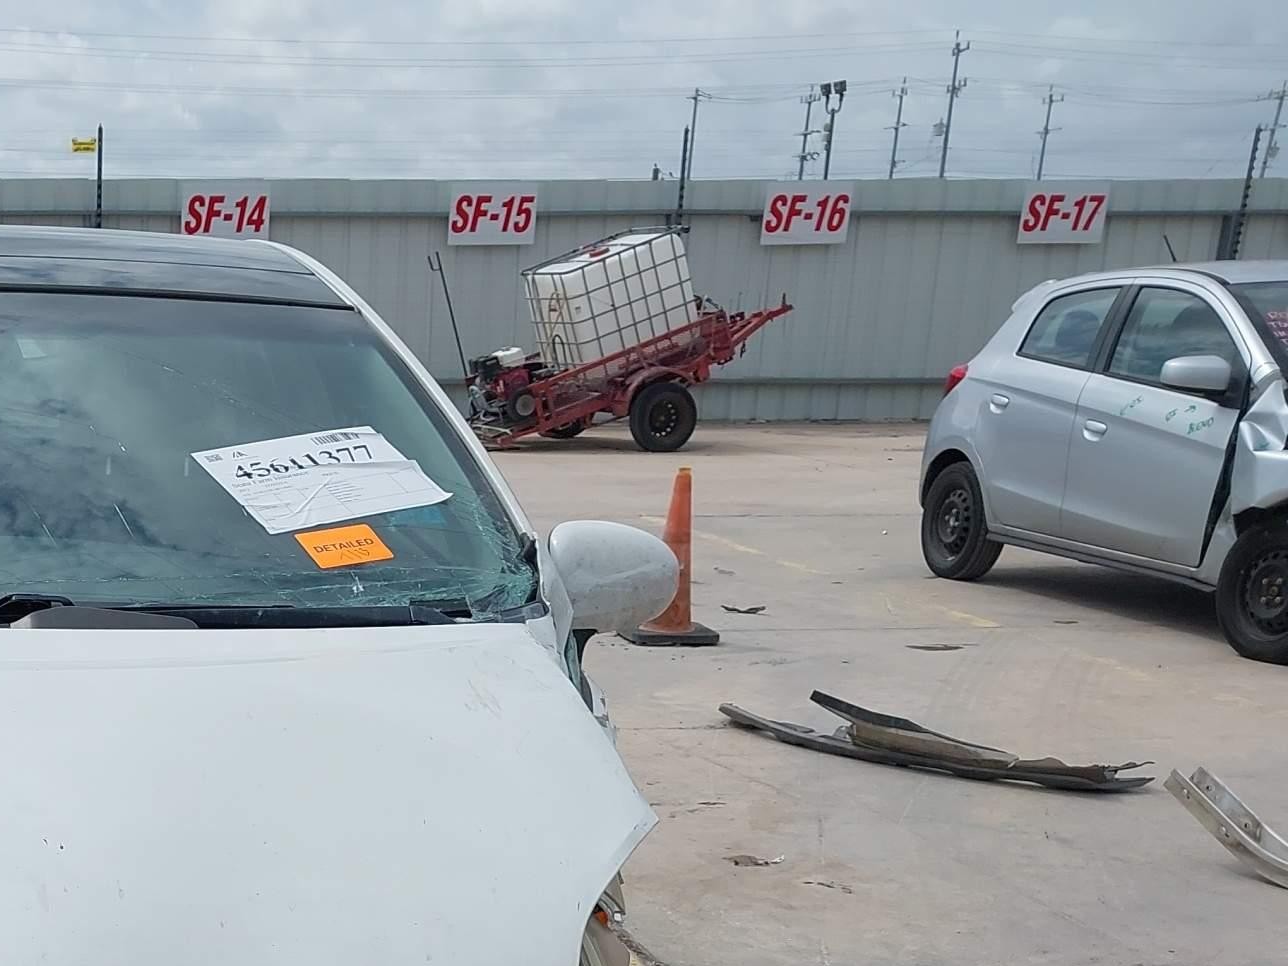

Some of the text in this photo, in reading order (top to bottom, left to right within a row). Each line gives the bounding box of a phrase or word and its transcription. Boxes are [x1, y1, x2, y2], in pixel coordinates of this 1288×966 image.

[182, 195, 263, 236] SF-14
[451, 195, 535, 234] SF-15
[764, 194, 850, 233] SF-16
[1021, 194, 1106, 232] SF-17
[235, 444, 374, 480] 45611377
[312, 537, 375, 554] DETAILED
